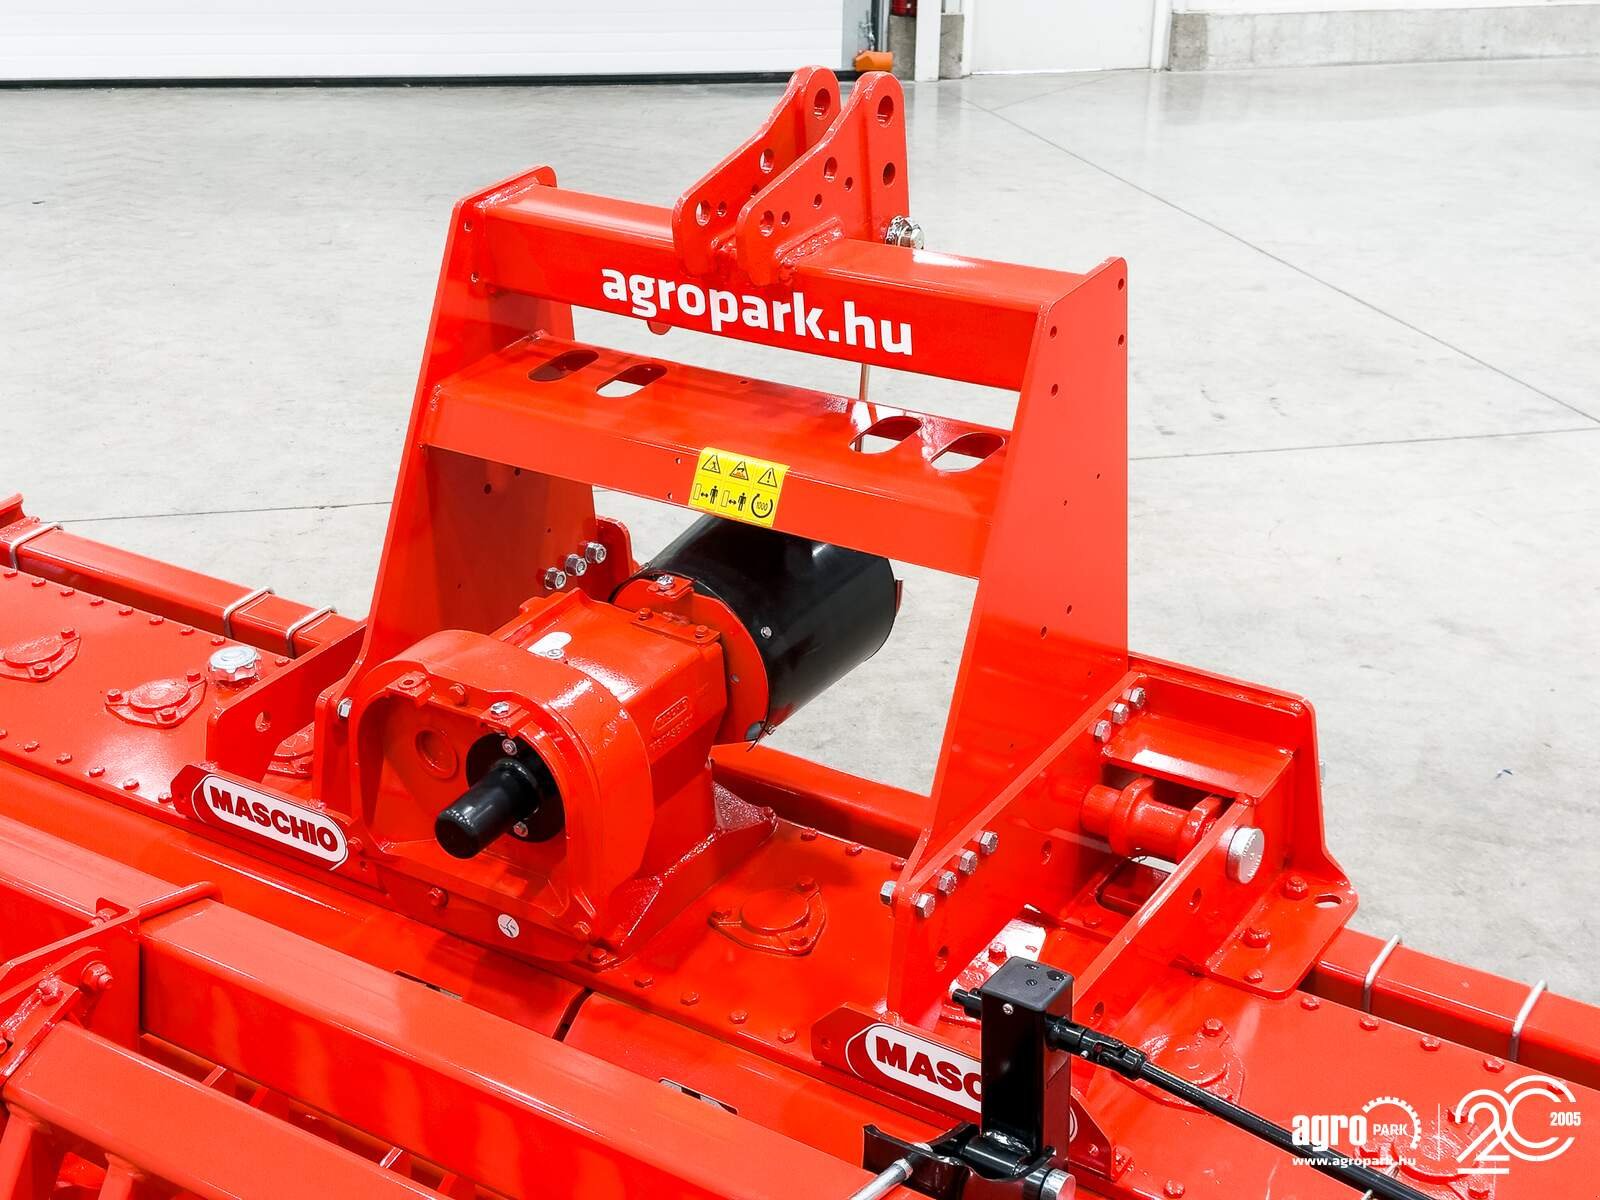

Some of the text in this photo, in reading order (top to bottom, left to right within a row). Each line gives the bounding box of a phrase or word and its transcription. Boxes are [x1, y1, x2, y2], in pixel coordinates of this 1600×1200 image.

[601, 268, 913, 356] agropark.hu
[210, 785, 338, 852] MASCHIO
[875, 1035, 982, 1100] MASC
